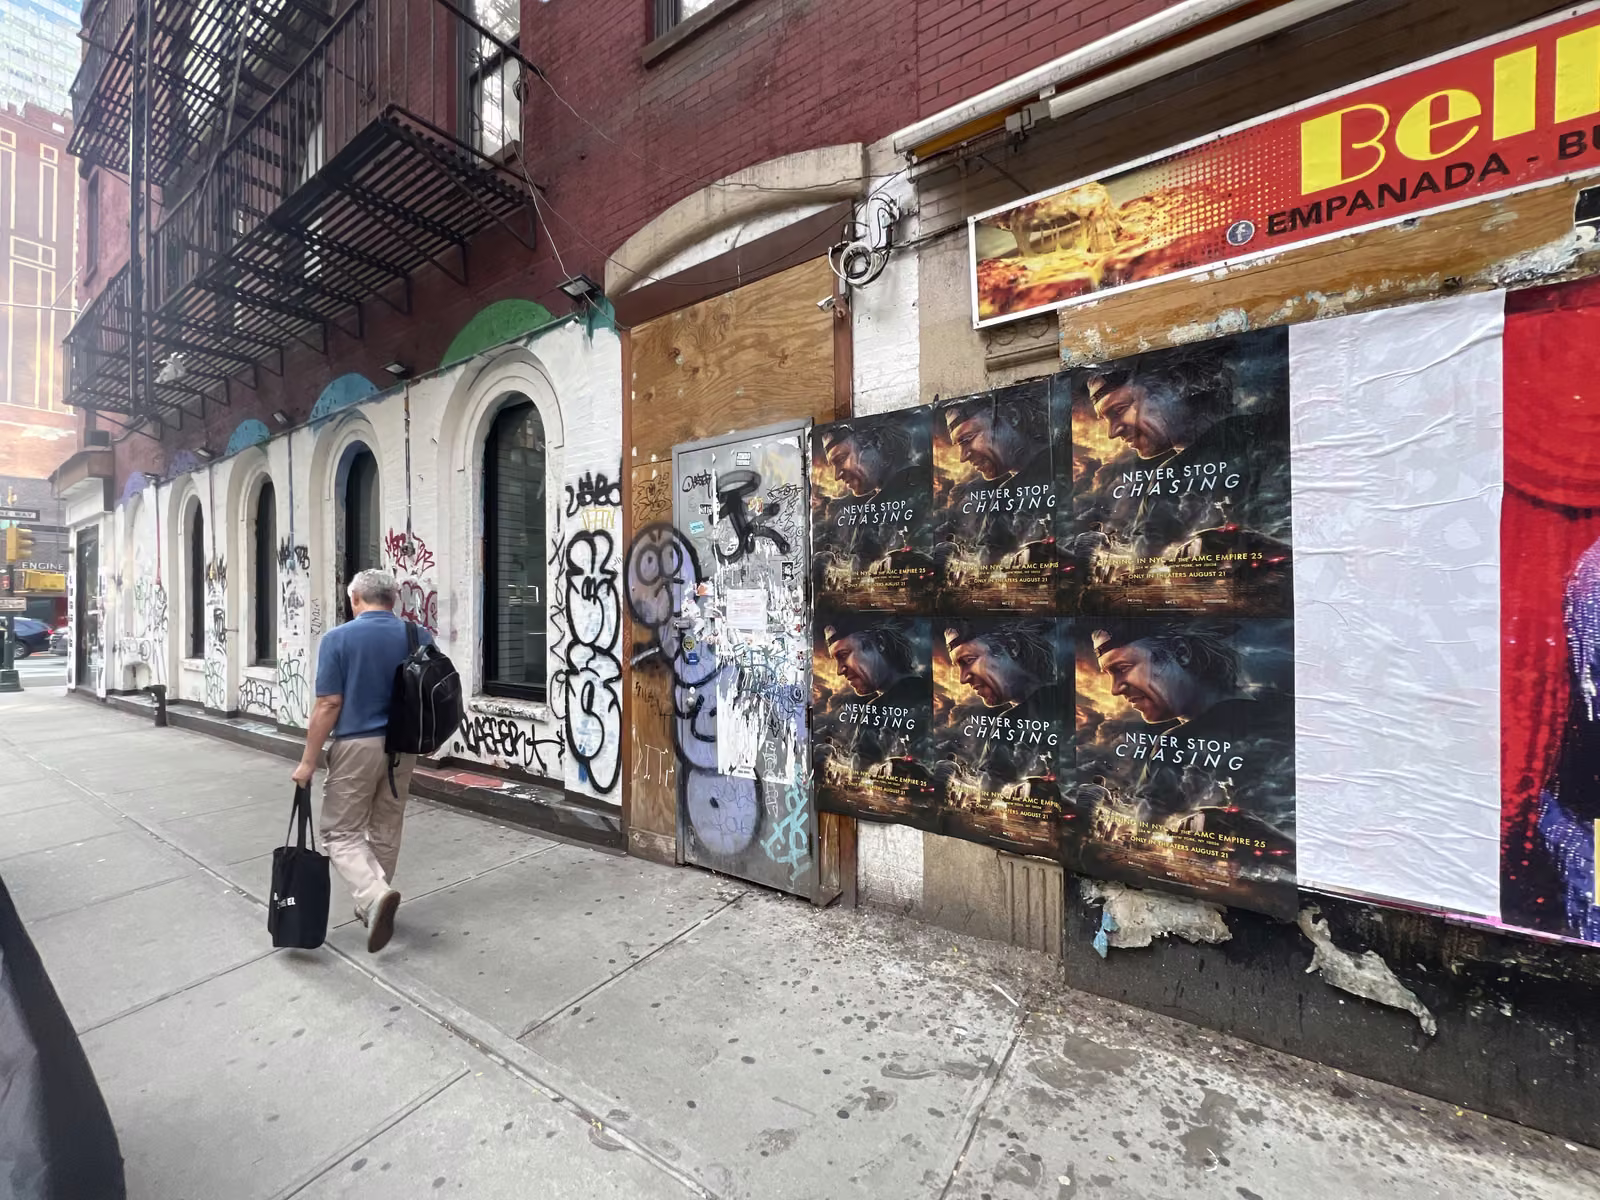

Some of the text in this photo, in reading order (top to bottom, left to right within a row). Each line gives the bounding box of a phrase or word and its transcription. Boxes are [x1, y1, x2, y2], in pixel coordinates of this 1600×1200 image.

[1300, 24, 1600, 196] Bell
[1267, 151, 1511, 237] EMPANADA
[1122, 462, 1228, 483] NEVER STOP
[970, 484, 1049, 501] NEVER STOP
[1112, 474, 1240, 499] CHASING
[843, 500, 906, 514] NEVER STOP
[962, 494, 1056, 514] CHASING
[838, 510, 913, 526] CHASING
[22, 562, 64, 570] ENGINE
[1148, 556, 1166, 564] NYC
[1191, 554, 1212, 562] AMC
[1216, 552, 1248, 561] EMPIRE
[1250, 552, 1263, 560] 25
[844, 703, 909, 717] NEVER STOP
[839, 712, 916, 730] CHASING
[971, 715, 1050, 731] NEVER STOP
[964, 726, 1058, 745] CHASING
[1126, 732, 1231, 753] NEVER STOP
[1115, 744, 1244, 771] CHASING
[900, 777, 919, 785] EMPIRE
[1139, 820, 1149, 828] IN
[1152, 822, 1168, 831] NYC
[1194, 830, 1215, 840] AMC
[1218, 834, 1250, 846] EMPIRE
[1254, 840, 1266, 848] 25
[1130, 835, 1146, 844] ONLY
[1158, 840, 1189, 851] THEATERS
[1190, 846, 1219, 857] AUGUST
